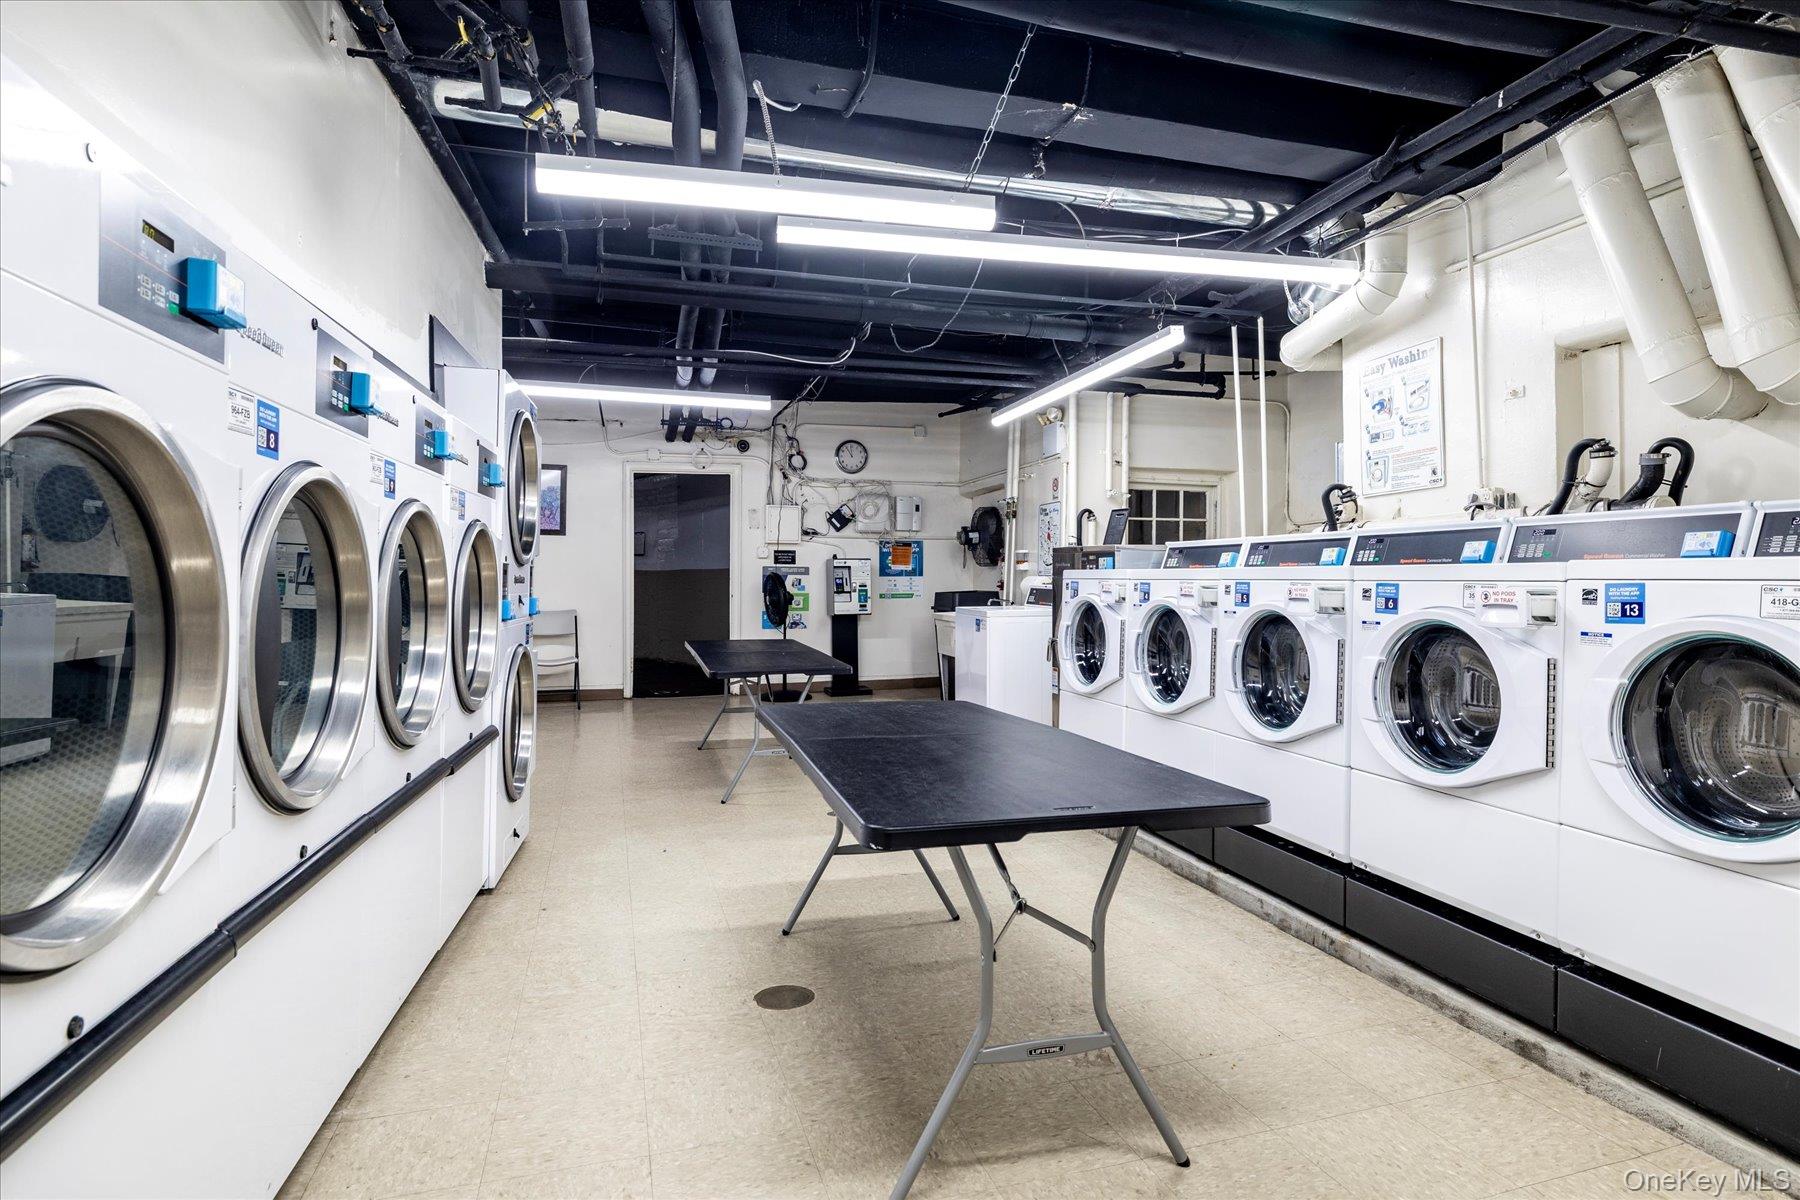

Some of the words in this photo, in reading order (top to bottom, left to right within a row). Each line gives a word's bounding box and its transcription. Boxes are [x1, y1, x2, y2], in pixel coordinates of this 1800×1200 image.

[1363, 363, 1386, 378] Easy
[231, 404, 251, 419] 964-FZB
[269, 433, 275, 449] 8
[1388, 599, 1394, 609] 6
[1624, 604, 1639, 616] 13
[1032, 1046, 1061, 1055] LIFETIME
